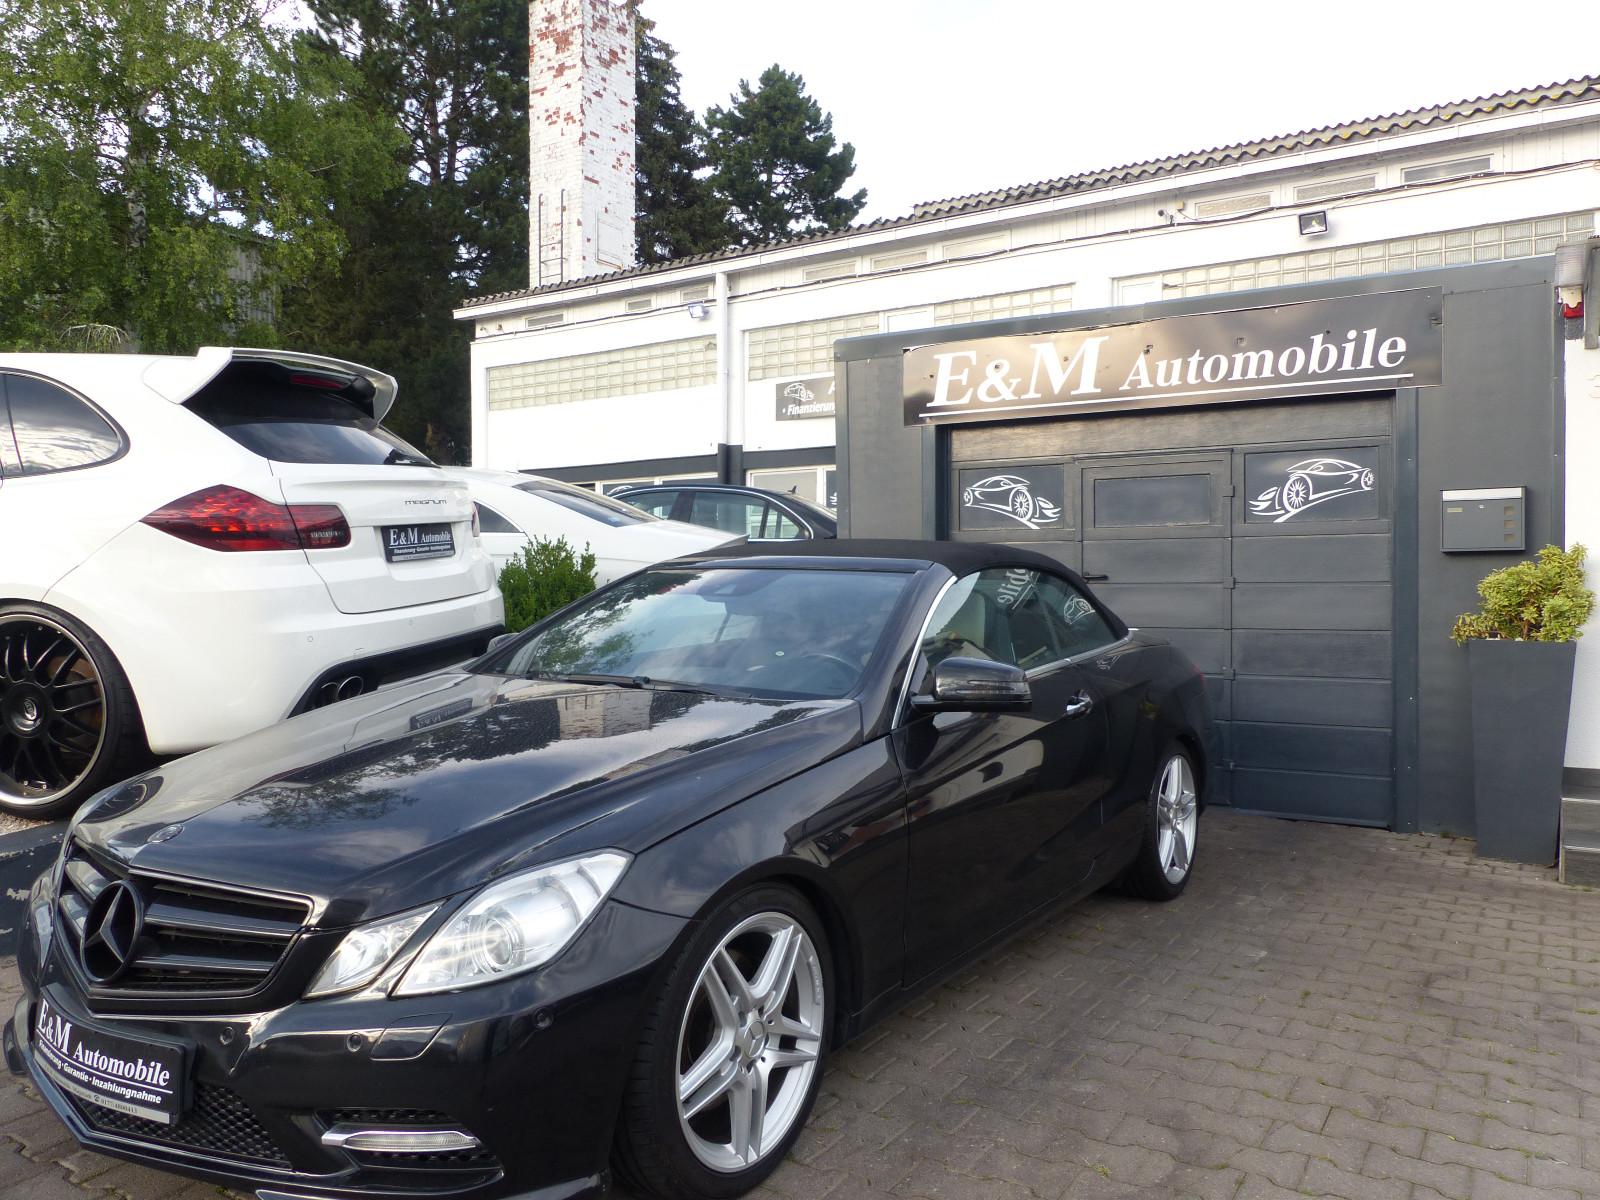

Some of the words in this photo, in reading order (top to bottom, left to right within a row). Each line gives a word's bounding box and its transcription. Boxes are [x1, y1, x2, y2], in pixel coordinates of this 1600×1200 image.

[926, 335, 1110, 408] E&M
[1119, 328, 1408, 391] Automobile
[788, 402, 835, 416] Finanzierun
[389, 527, 419, 546] E&M
[420, 531, 452, 544] Automobile
[37, 998, 72, 1055] E&M
[73, 1041, 170, 1087] Automobile
[63, 1062, 89, 1082] Garantie
[91, 1076, 162, 1104] Inzahlungnahme
